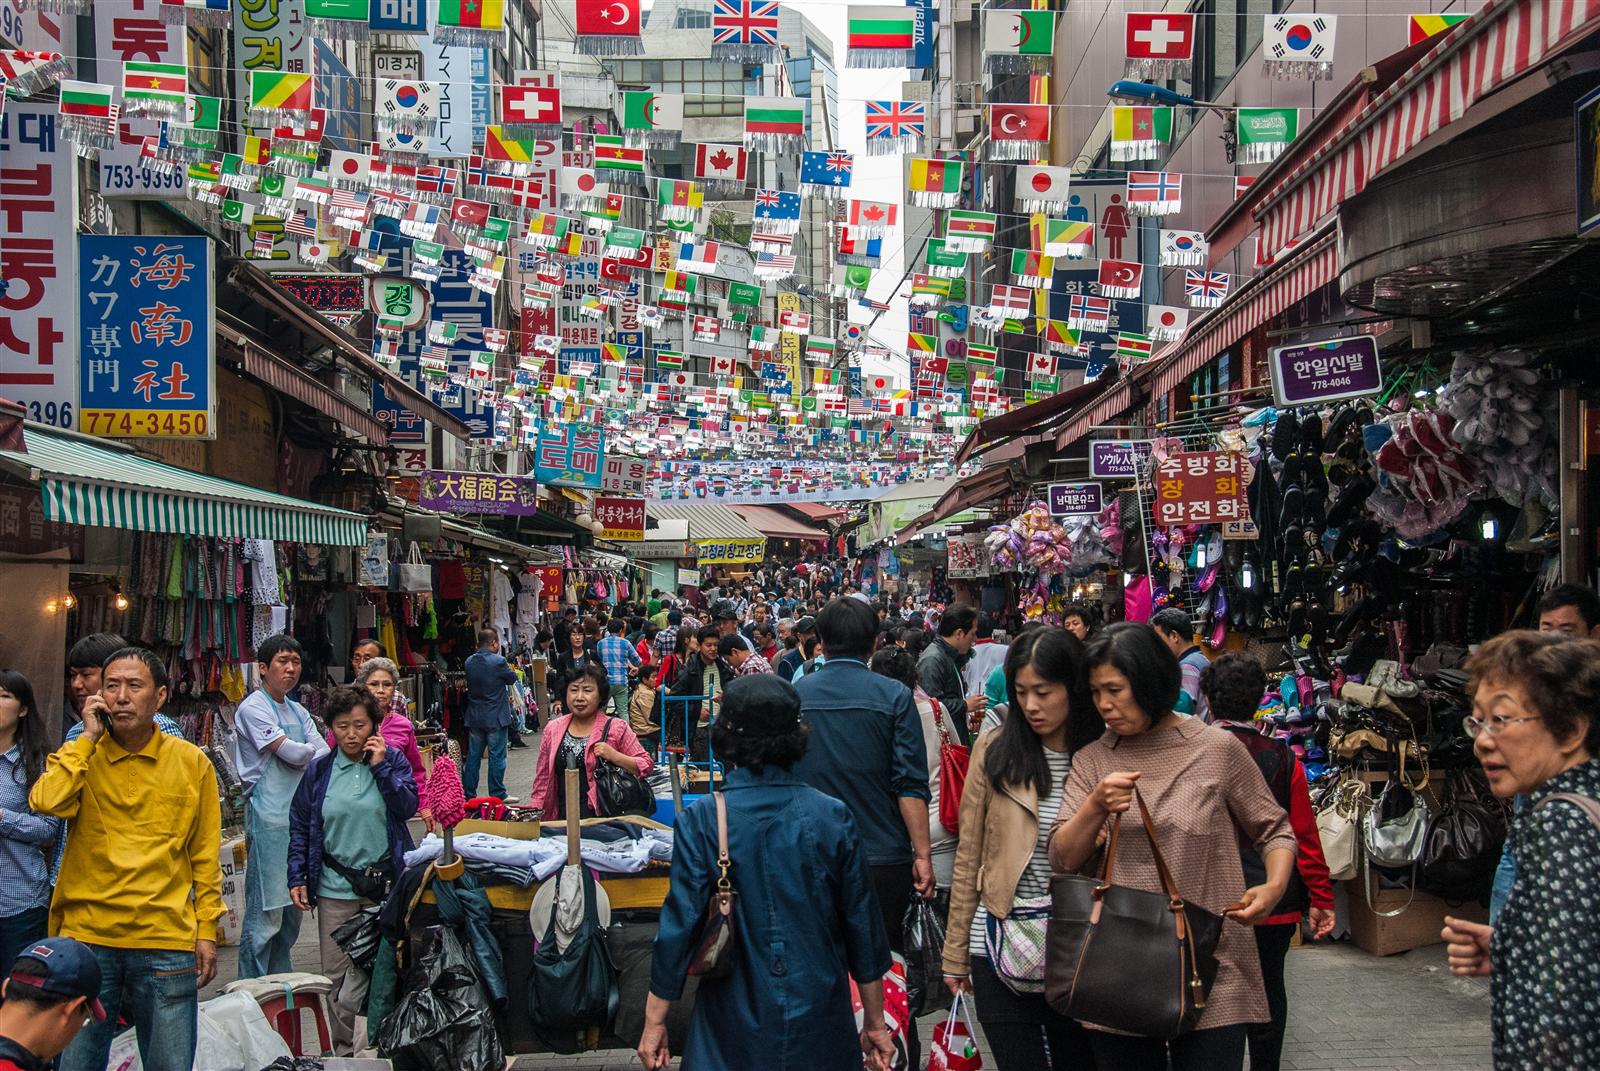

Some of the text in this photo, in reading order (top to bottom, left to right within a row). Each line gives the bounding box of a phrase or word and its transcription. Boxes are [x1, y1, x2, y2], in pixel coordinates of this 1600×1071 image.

[377, 56, 419, 71] 이경자
[103, 165, 184, 190] 753-9396
[130, 243, 196, 402] 海南社
[1293, 353, 1363, 379] 한일신발
[1312, 376, 1351, 390] 778-4046
[87, 412, 207, 436] 774-3450
[539, 447, 598, 473] 도매
[1160, 455, 1238, 478] 주방화
[439, 475, 517, 502] 大福商会
[596, 505, 643, 524] 명동칼국수
[1162, 499, 1239, 522] 안전화
